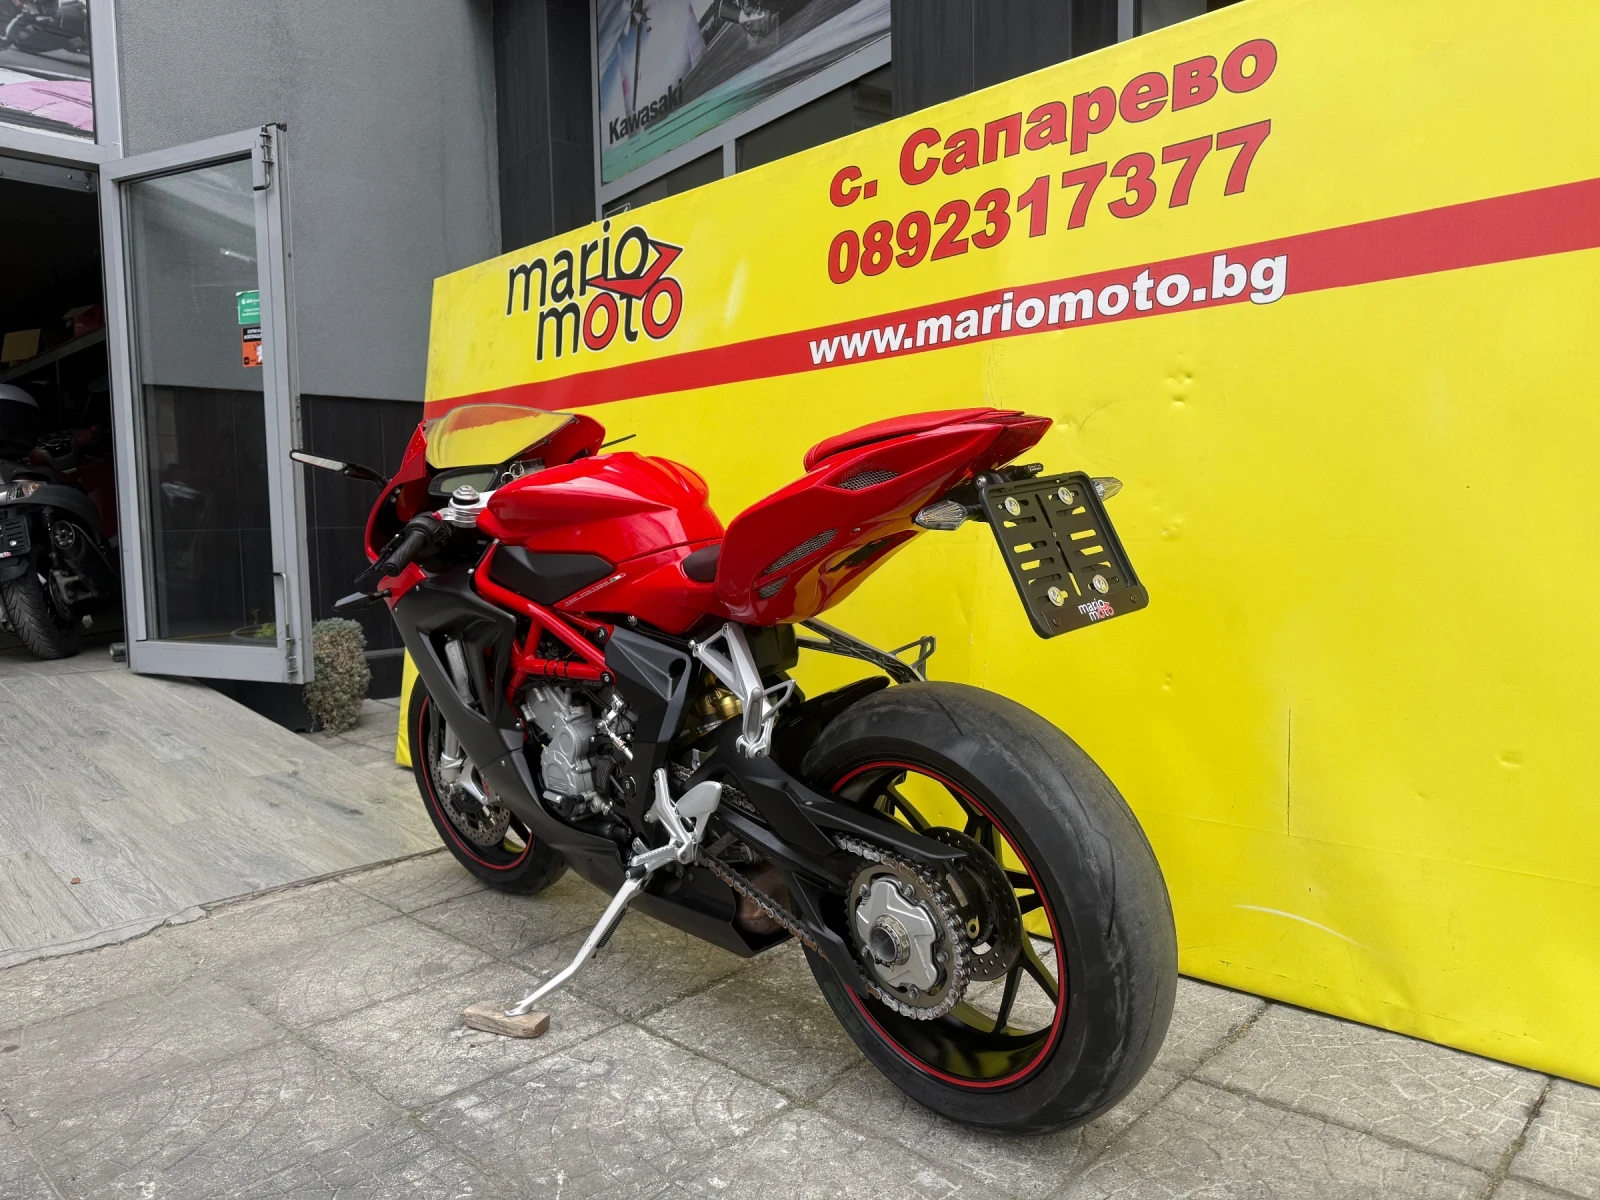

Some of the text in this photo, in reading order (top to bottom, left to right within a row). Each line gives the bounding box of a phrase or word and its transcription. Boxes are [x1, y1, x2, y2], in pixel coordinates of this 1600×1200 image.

[609, 78, 683, 144] Kawasaki
[899, 38, 1278, 186] Сапарево
[827, 118, 1272, 285] 0892317377
[506, 219, 650, 316] mario
[808, 253, 1288, 365] www.mariomoto.bg
[536, 276, 683, 361] moto
[1077, 598, 1105, 615] mario
